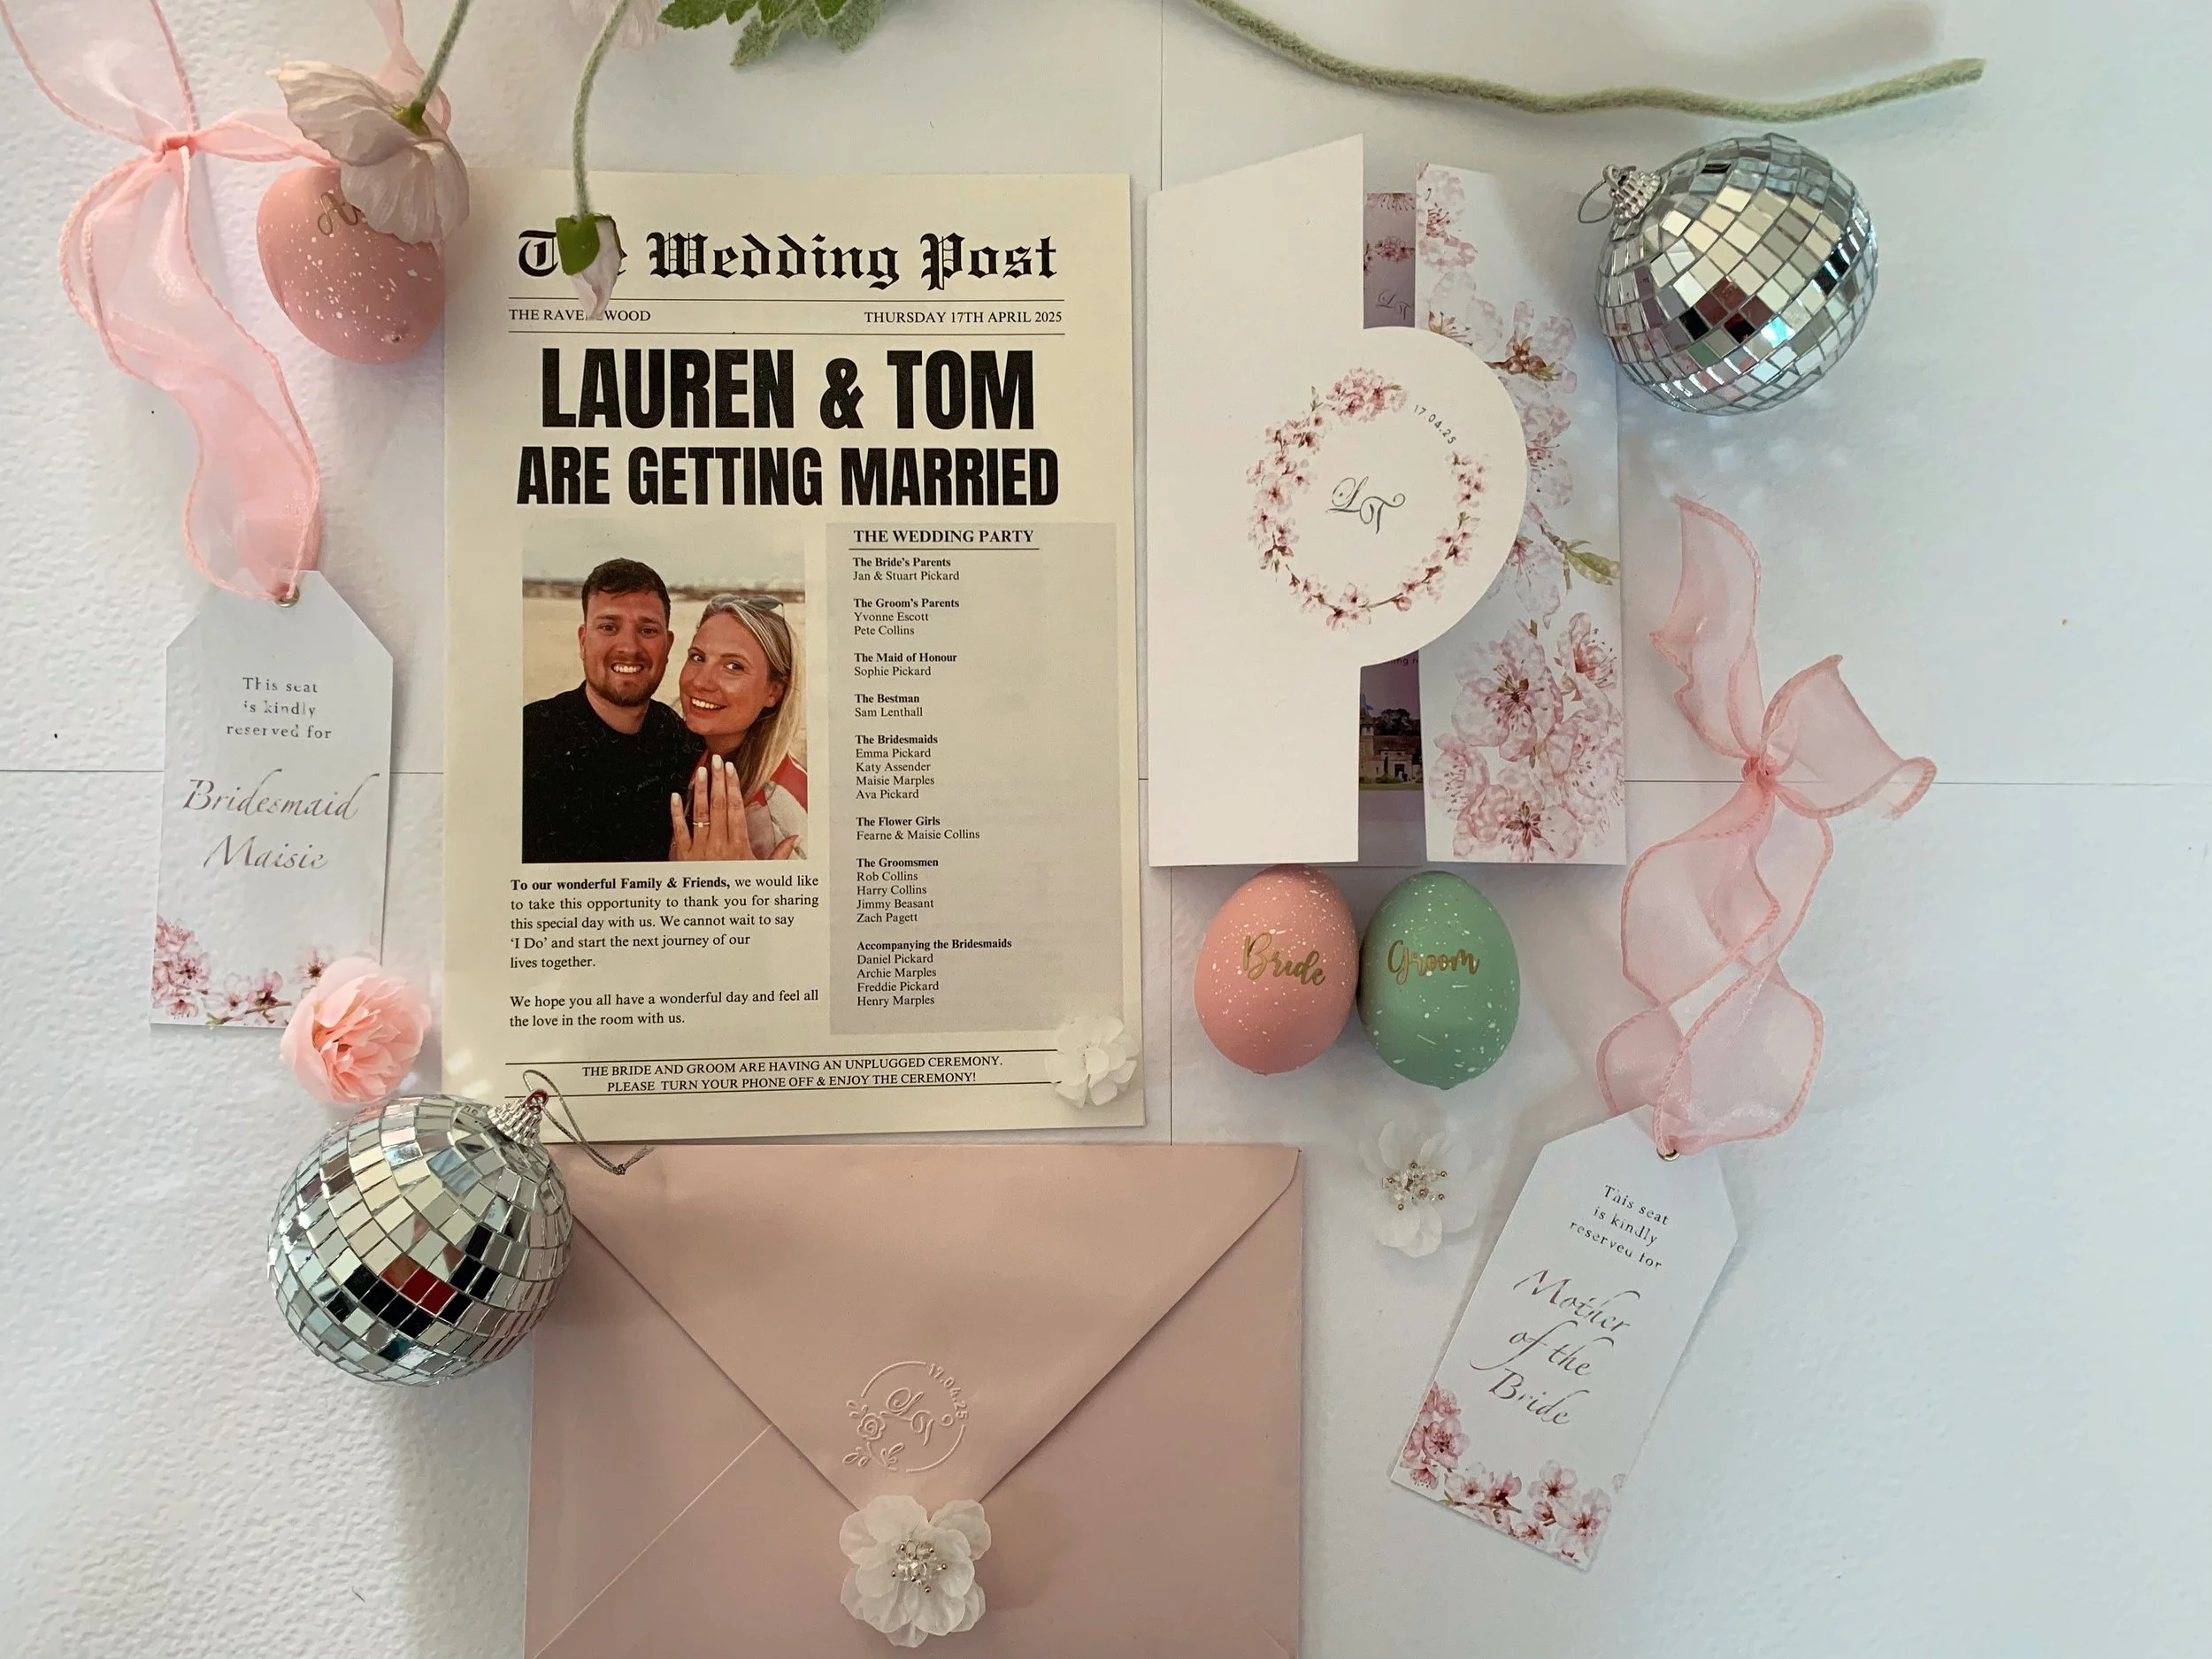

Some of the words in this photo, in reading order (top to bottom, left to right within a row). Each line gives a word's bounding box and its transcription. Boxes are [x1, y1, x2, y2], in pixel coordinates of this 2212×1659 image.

[647, 232, 899, 290] Wedding
[920, 233, 1056, 290] Post
[509, 309, 540, 320] THE
[543, 310, 651, 321] RAVEWOOD
[864, 312, 946, 323] THURSDAY
[952, 312, 983, 323] 17TH
[987, 311, 1031, 322] APRIL
[1035, 311, 1062, 322] 2025
[542, 348, 794, 428] LAUREN
[820, 358, 864, 429] &
[887, 350, 1033, 429] TOM
[1415, 405, 1456, 444] 17.04.25
[517, 446, 610, 504] ARE
[628, 447, 822, 505] GETTING
[841, 448, 1058, 505] MARRIED
[854, 530, 888, 542] THE
[893, 530, 973, 542] WEDDING
[979, 530, 1033, 542] PARTY
[853, 557, 872, 566] The
[913, 557, 950, 566] Parents
[853, 572, 870, 580] Jan
[874, 571, 882, 580] &
[887, 571, 917, 580] Stuart
[921, 571, 959, 580] Pickard
[854, 598, 872, 608] The
[922, 598, 959, 607] Parents
[854, 612, 894, 621] Yvonne
[897, 612, 928, 621] Escott
[855, 626, 875, 634] Pete
[879, 626, 914, 634] Collins
[854, 653, 873, 662] The
[877, 653, 902, 662] Maid
[906, 653, 917, 662] of
[919, 653, 956, 662] Honour
[855, 666, 889, 678] Sophie
[893, 666, 931, 676] Pickard
[242, 677, 278, 690] This
[286, 680, 318, 693] seat
[855, 694, 873, 703] The
[878, 694, 919, 703] Bestman
[243, 701, 256, 712] is
[264, 701, 315, 718] kindly
[856, 708, 877, 717] Sam
[881, 707, 922, 717] Lenthall
[227, 725, 299, 738] reserved
[307, 726, 332, 739] for
[855, 735, 874, 744] The
[878, 734, 938, 744] Bridesmaids
[856, 749, 888, 758] Emma
[893, 748, 931, 757] Pickard
[856, 763, 881, 773] Katy
[884, 762, 931, 772] Assender
[856, 775, 889, 785] Maisie
[894, 775, 934, 787] Marples
[183, 768, 380, 819] Bridesmaid
[856, 790, 877, 799] Ava
[880, 789, 918, 799] Pickard
[856, 818, 875, 826] The
[879, 817, 912, 826] Flower
[916, 817, 941, 826] Girls
[857, 831, 892, 840] Fearne
[895, 830, 903, 840] &
[908, 830, 941, 840] Maisie
[944, 829, 979, 839] Collins
[204, 834, 327, 869] Maisie
[856, 858, 875, 867] The
[879, 858, 938, 867] Groomsmen
[857, 872, 879, 881] Rob
[882, 871, 918, 881] Collins
[511, 879, 527, 890] To
[557, 879, 616, 889] wonderful
[621, 878, 662, 891] Family
[667, 878, 677, 887] &
[682, 877, 730, 889] Friends,
[756, 876, 792, 887] would
[797, 875, 818, 886] like
[857, 886, 887, 897] Harry
[891, 885, 926, 895] Collins
[511, 901, 523, 910] to
[528, 898, 555, 910] take
[560, 898, 582, 909] this
[588, 897, 661, 911] opportunity
[666, 898, 679, 907] to
[684, 895, 719, 907] thank
[724, 898, 747, 909] you
[752, 895, 770, 906] for
[774, 895, 818, 907] sharing
[856, 899, 891, 910] Jimmy
[895, 899, 933, 908] Beasant
[511, 918, 533, 929] this
[537, 918, 577, 932] special
[581, 917, 604, 930] day
[608, 916, 634, 927] with
[660, 916, 680, 926] We
[684, 917, 726, 926] cannot
[729, 914, 755, 926] wait
[759, 916, 771, 925] to
[775, 917, 794, 926] say
[856, 913, 882, 922] Zach
[886, 912, 918, 924] Pagett
[857, 940, 930, 952] Accompanying
[933, 940, 949, 949] the
[952, 939, 1011, 949] Bridesmaids
[857, 954, 891, 964] Daniel
[895, 953, 933, 964] Pickard
[1242, 933, 1325, 986] Bride
[1387, 940, 1479, 985] Groom
[857, 968, 891, 978] Archie
[895, 967, 936, 979] Marples
[857, 981, 896, 992] Freddie
[900, 981, 939, 991] Pickard
[857, 996, 889, 1008] Henry
[893, 995, 934, 1006] Marples
[582, 1066, 609, 1076] THE
[612, 1065, 651, 1076] BRIDE
[655, 1064, 683, 1074] AND
[687, 1063, 735, 1073] GROOM
[739, 1063, 765, 1072] ARE
[769, 1061, 820, 1072] HAVING
[823, 1060, 841, 1070] AN
[845, 1058, 925, 1069] UNPLUGGED
[928, 1056, 1002, 1067] CEREMONY.
[608, 1081, 655, 1092] PLEASE
[661, 1080, 698, 1090] TURN
[701, 1079, 738, 1089] YOUR
[742, 1078, 786, 1088] PHONE
[789, 1077, 814, 1087] OFF
[817, 1077, 826, 1086] &
[829, 1075, 871, 1087] ENJOY
[872, 1074, 898, 1084] THE
[901, 1072, 978, 1085] CEREMONY!
[1603, 1186, 1634, 1209] This
[1639, 1206, 1669, 1225] seat
[1593, 1207, 1605, 1219] is
[1610, 1214, 1657, 1246] kindly
[1513, 1270, 1640, 1331] Mother
[1470, 1320, 1578, 1370] of
[1548, 1337, 1614, 1375] the
[1488, 1368, 1589, 1425] Bride
